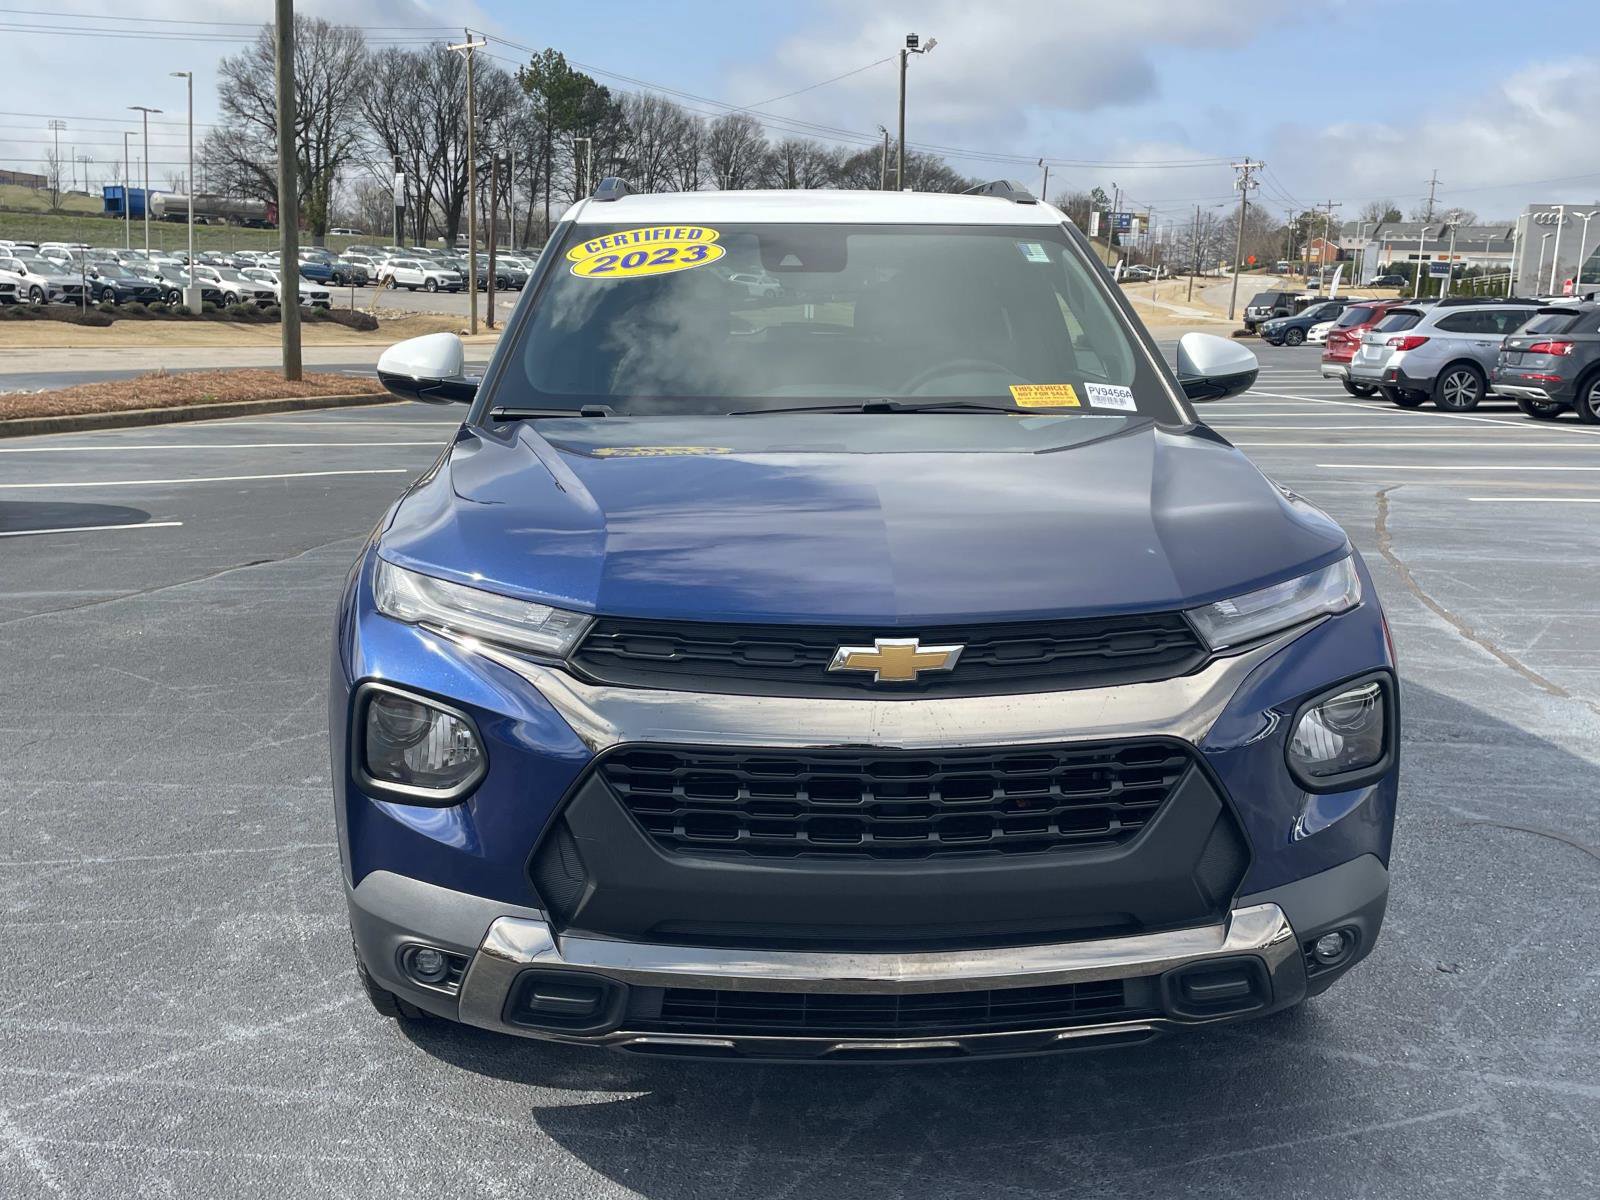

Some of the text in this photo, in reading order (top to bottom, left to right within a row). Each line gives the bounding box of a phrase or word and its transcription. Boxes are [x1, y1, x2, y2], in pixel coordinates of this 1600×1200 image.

[584, 228, 704, 254] CERTIFIED
[587, 245, 710, 274] 2023
[1088, 386, 1133, 398] PV9456A
